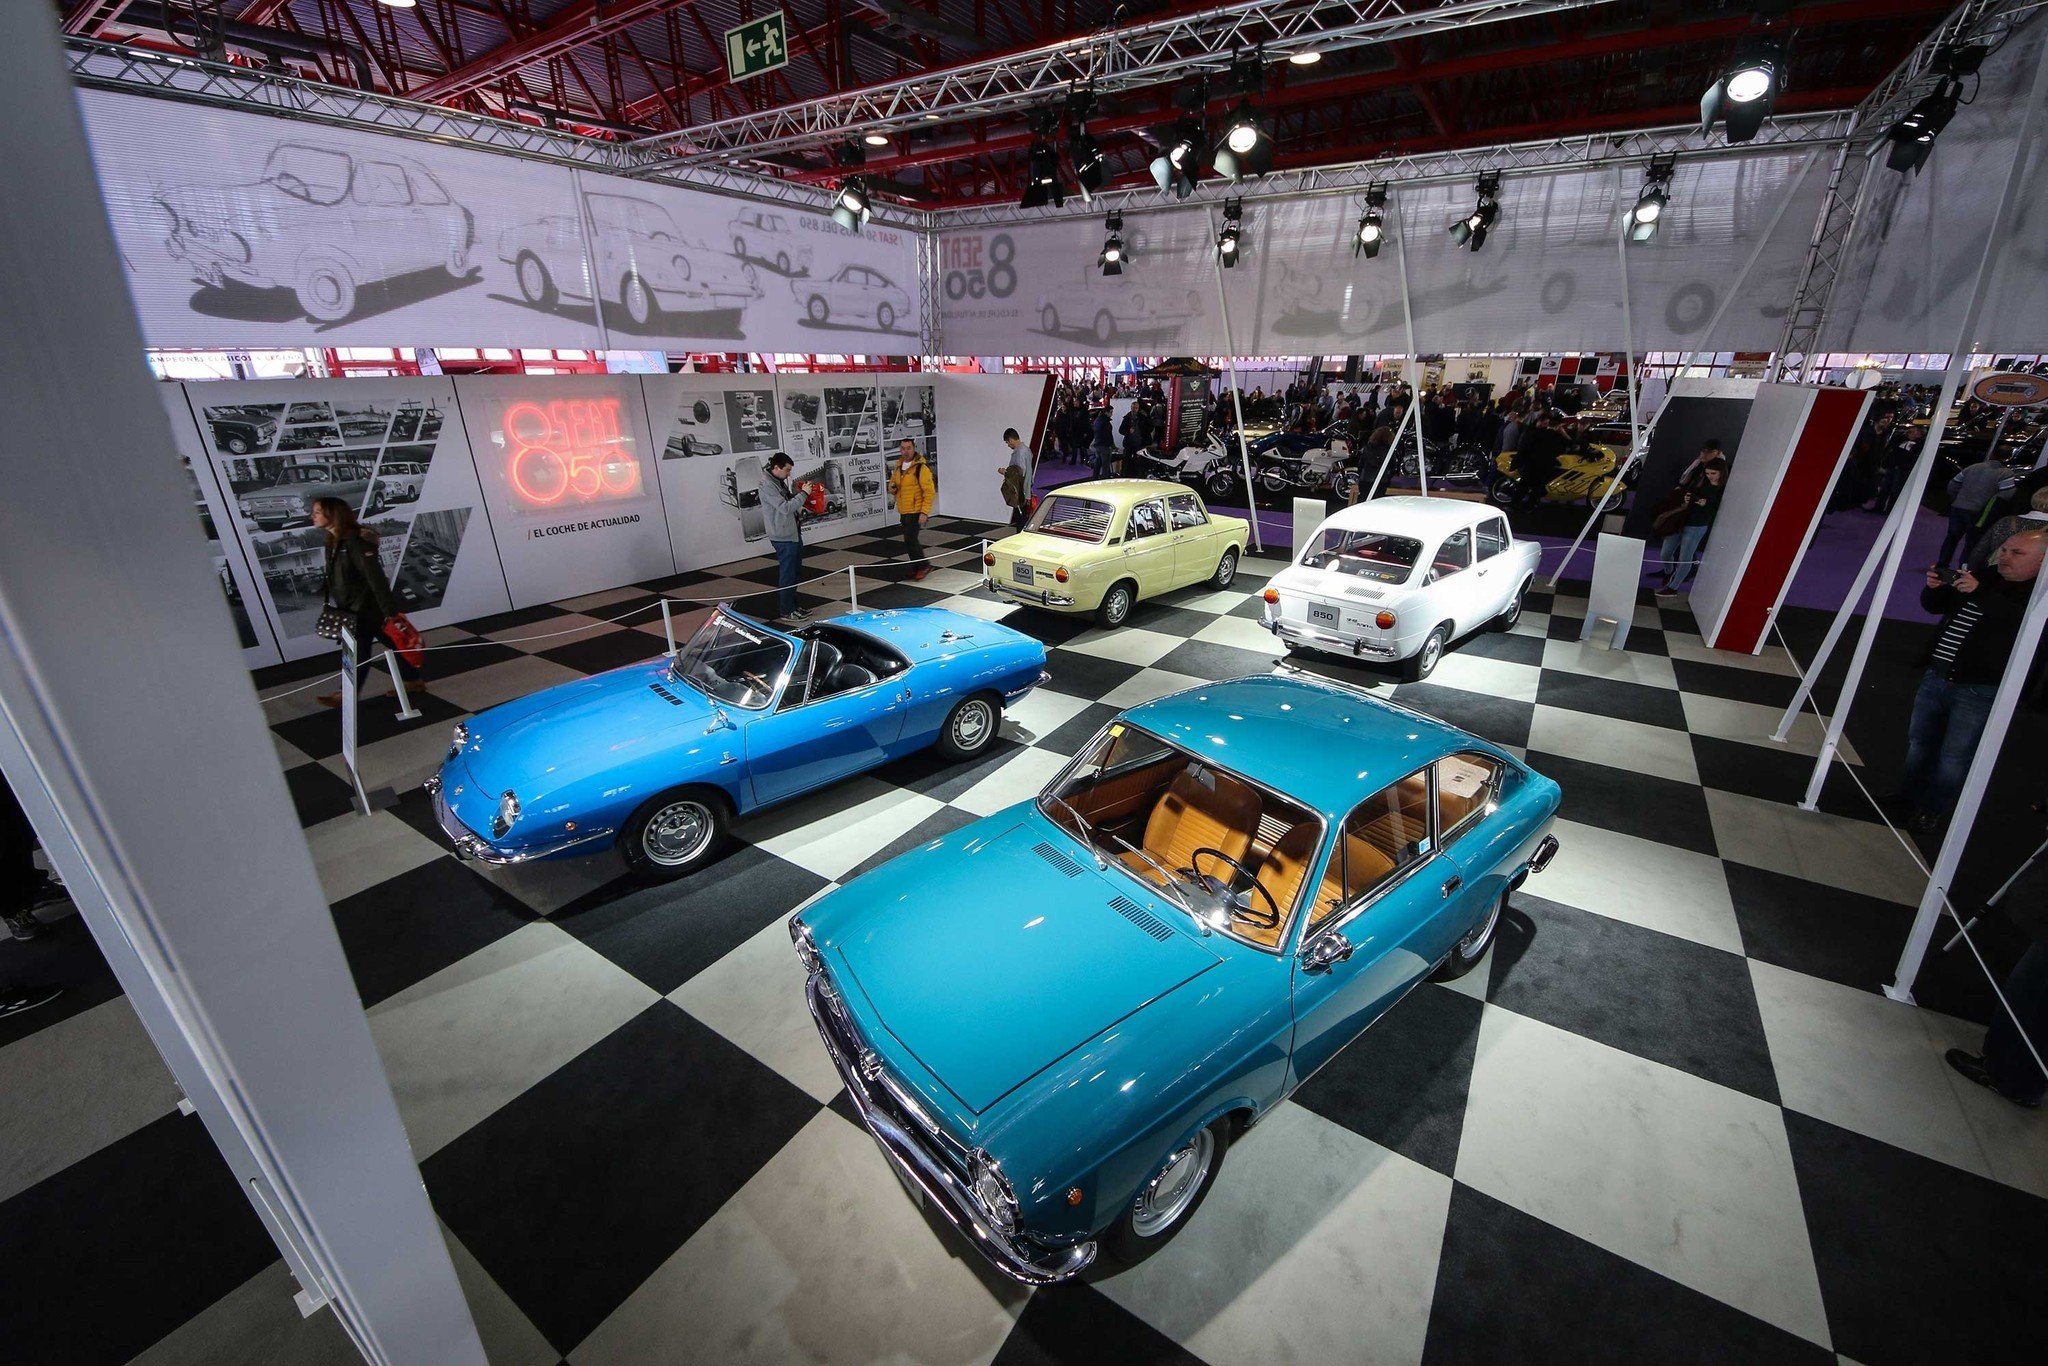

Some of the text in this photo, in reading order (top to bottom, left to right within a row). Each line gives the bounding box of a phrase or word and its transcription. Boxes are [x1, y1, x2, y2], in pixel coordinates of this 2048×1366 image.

[548, 398, 621, 449] SEAT
[505, 403, 637, 504] 850
[533, 514, 641, 538] EL COCHE DE ACTUALIDAD
[1016, 566, 1030, 575] 850
[1312, 610, 1334, 621] 850
